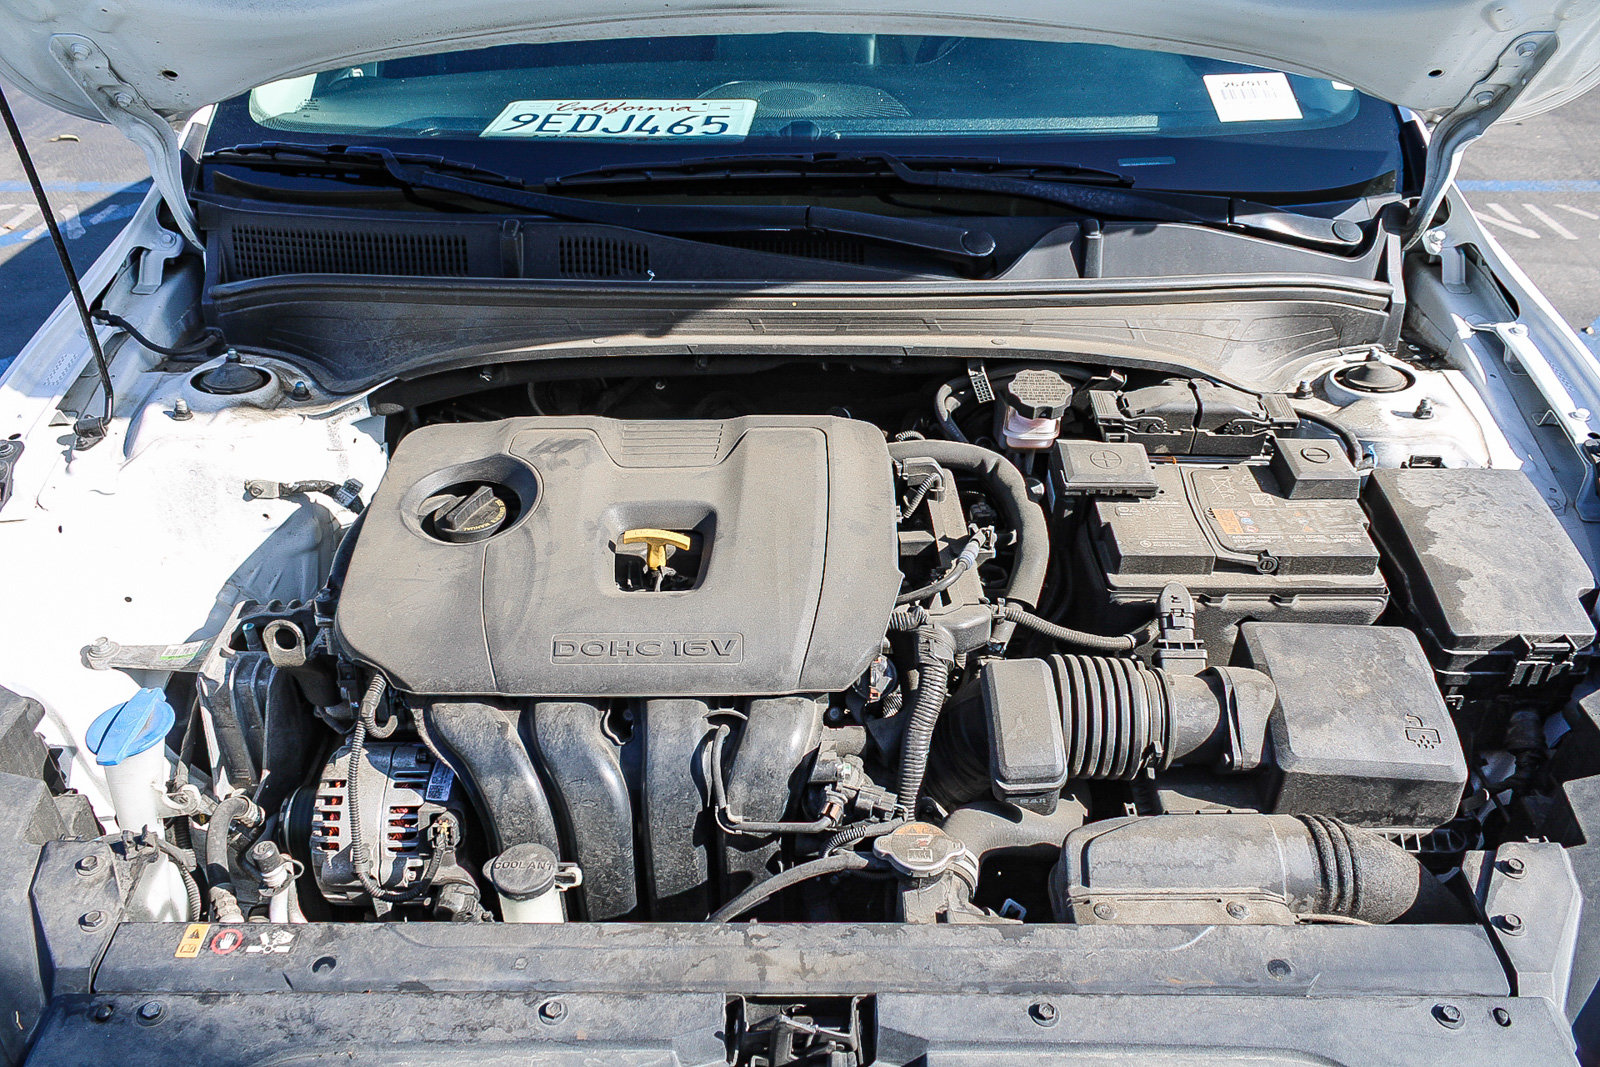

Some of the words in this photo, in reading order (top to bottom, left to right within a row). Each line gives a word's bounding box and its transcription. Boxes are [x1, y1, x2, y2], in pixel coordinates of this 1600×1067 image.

[556, 101, 707, 114] California
[502, 112, 730, 136] 9EDJ465
[552, 639, 664, 658] DOHC
[673, 639, 738, 658] 16V
[494, 860, 554, 872] COOLANT
